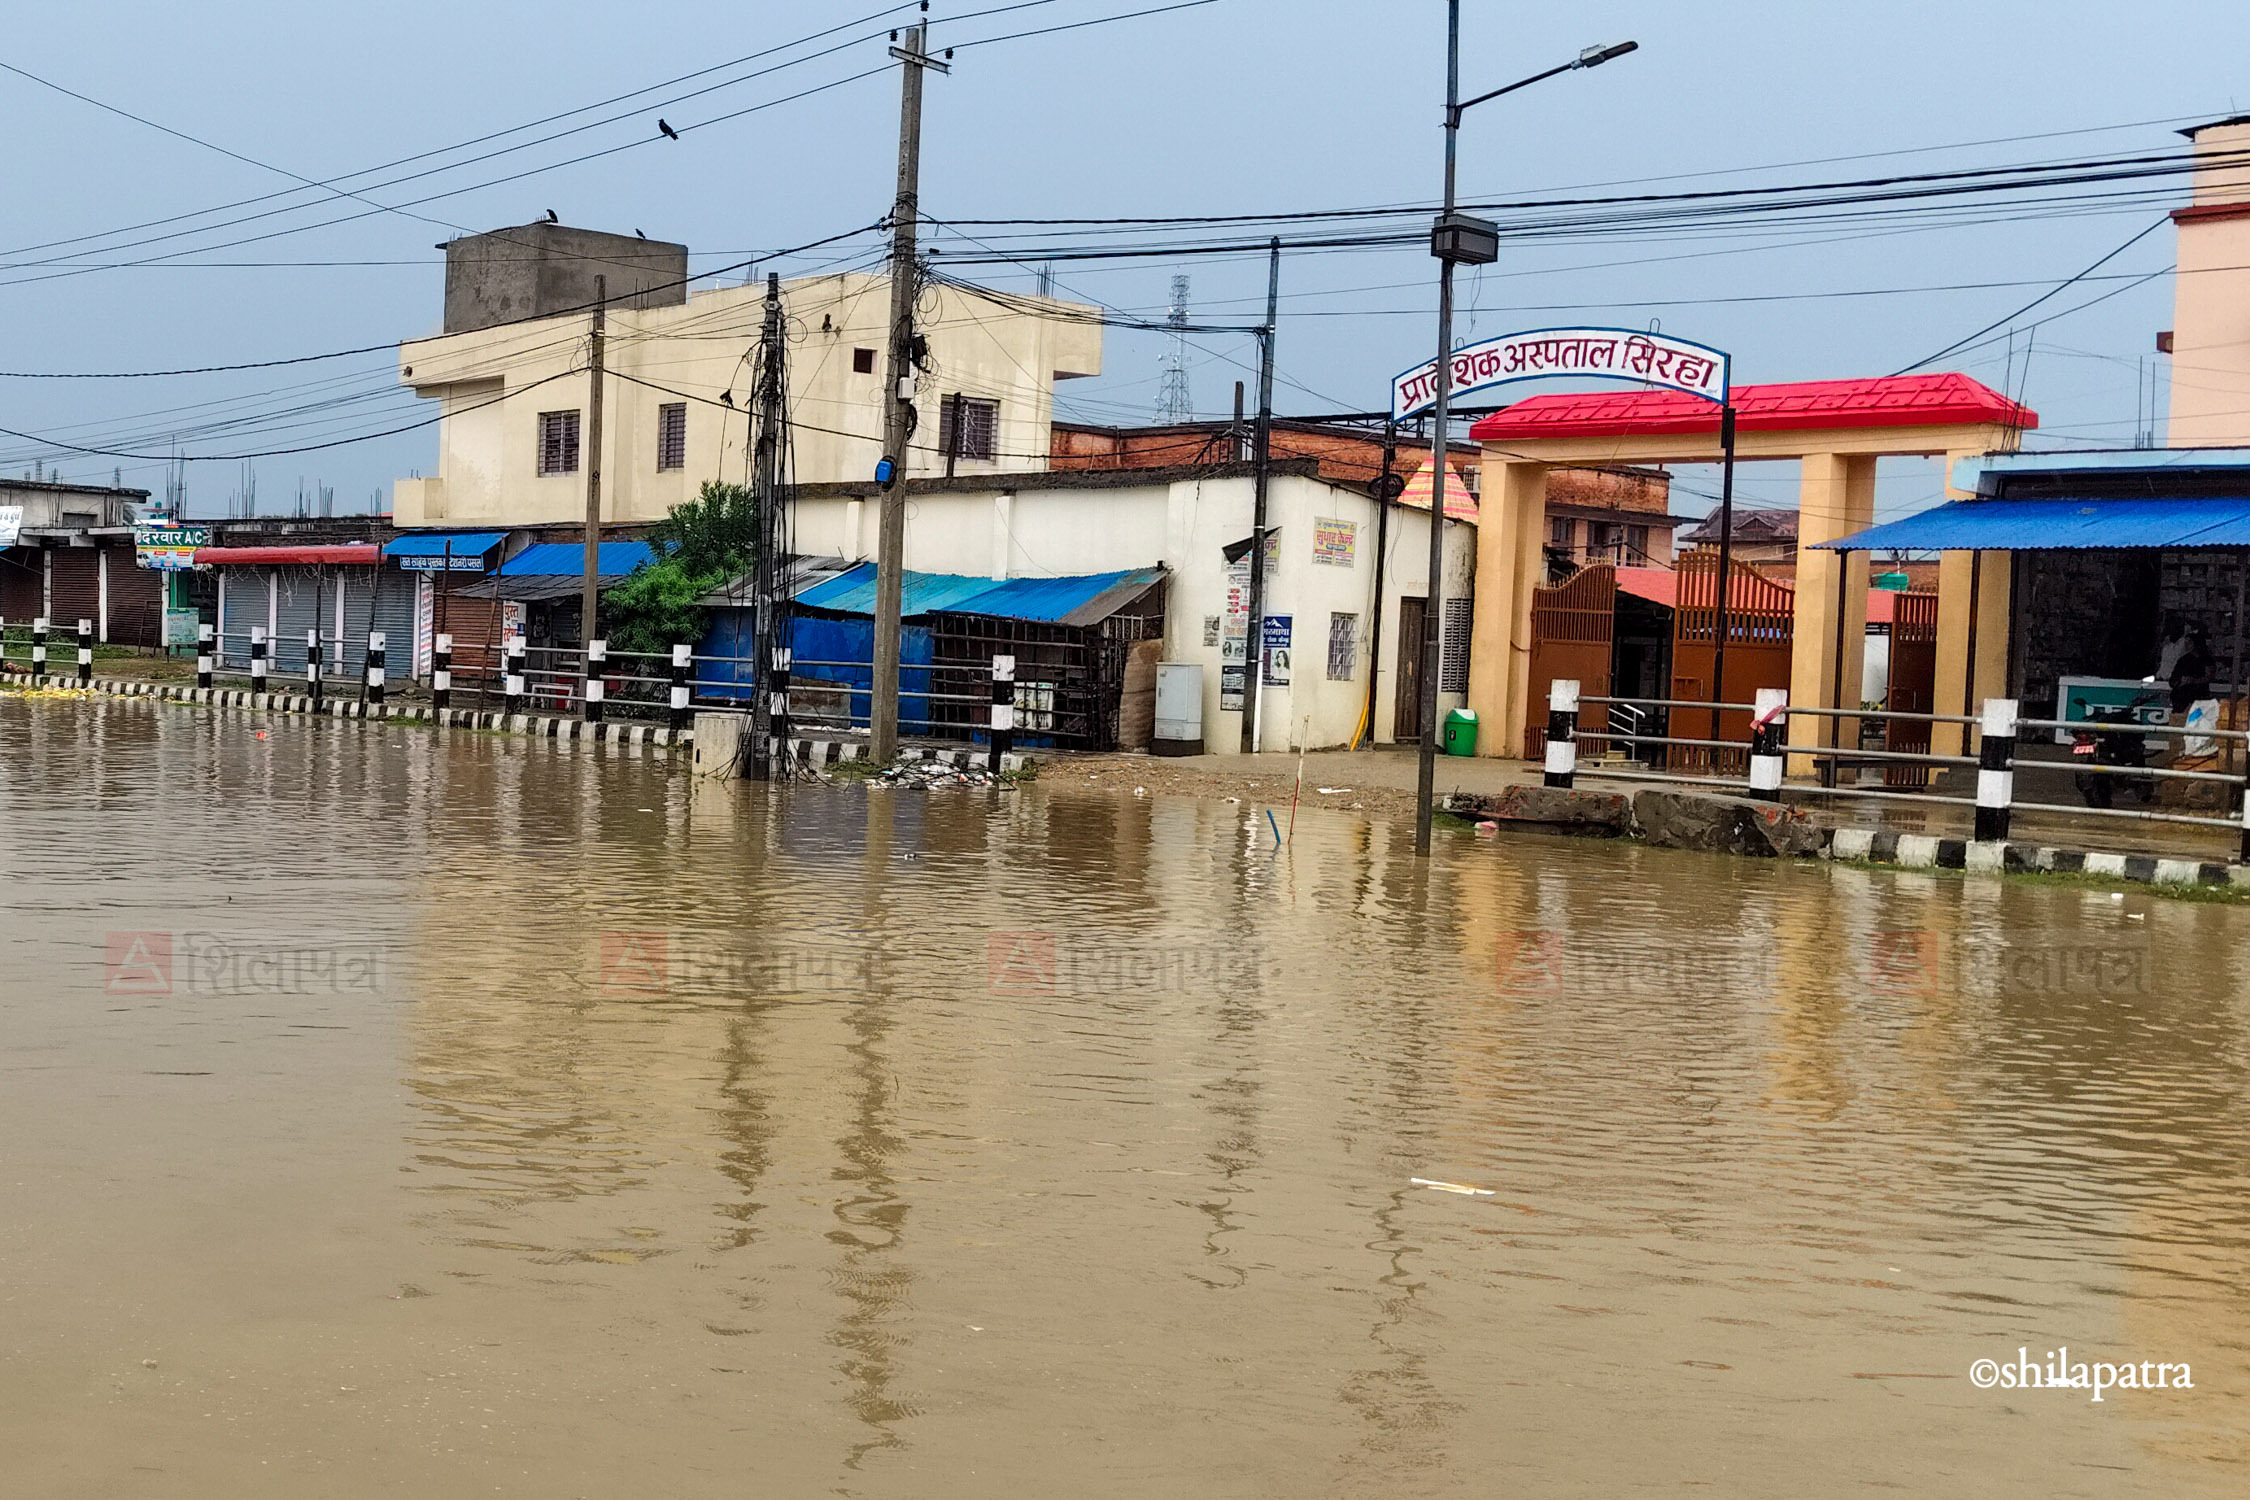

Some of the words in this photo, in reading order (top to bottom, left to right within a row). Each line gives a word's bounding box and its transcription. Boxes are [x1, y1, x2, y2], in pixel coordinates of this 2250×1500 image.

[1503, 338, 1618, 373] अस्पताल
[1622, 335, 1719, 389] सिरहा
[184, 530, 203, 545] A/C
